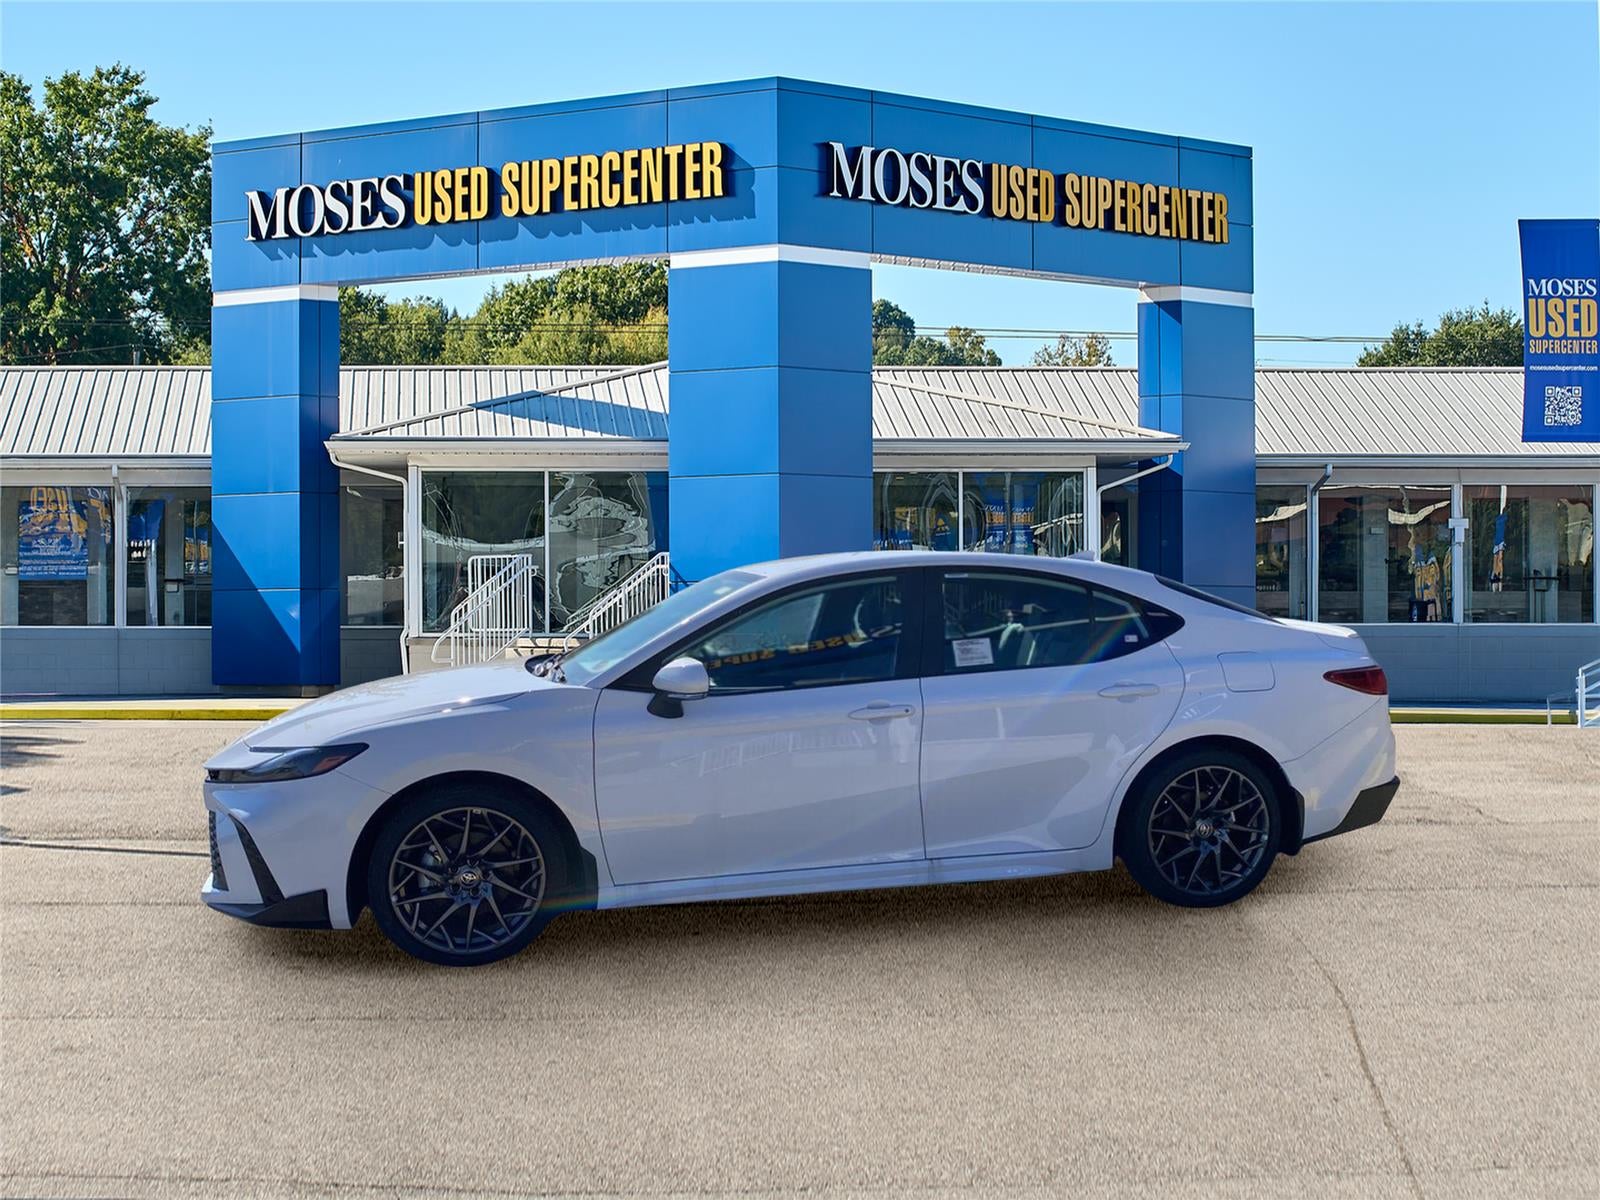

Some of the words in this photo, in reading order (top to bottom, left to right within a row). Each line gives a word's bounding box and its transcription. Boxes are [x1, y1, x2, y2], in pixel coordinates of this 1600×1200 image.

[244, 174, 406, 241] MOSES
[413, 166, 489, 225] USED
[500, 141, 724, 218] SUPERCENTER
[828, 141, 985, 215] MOSES
[990, 162, 1056, 222] USED
[1064, 172, 1230, 244] SUPERCENTER
[1527, 278, 1598, 297] MOSES
[1528, 298, 1598, 338] USED
[1529, 339, 1598, 355] SUPERCENTER
